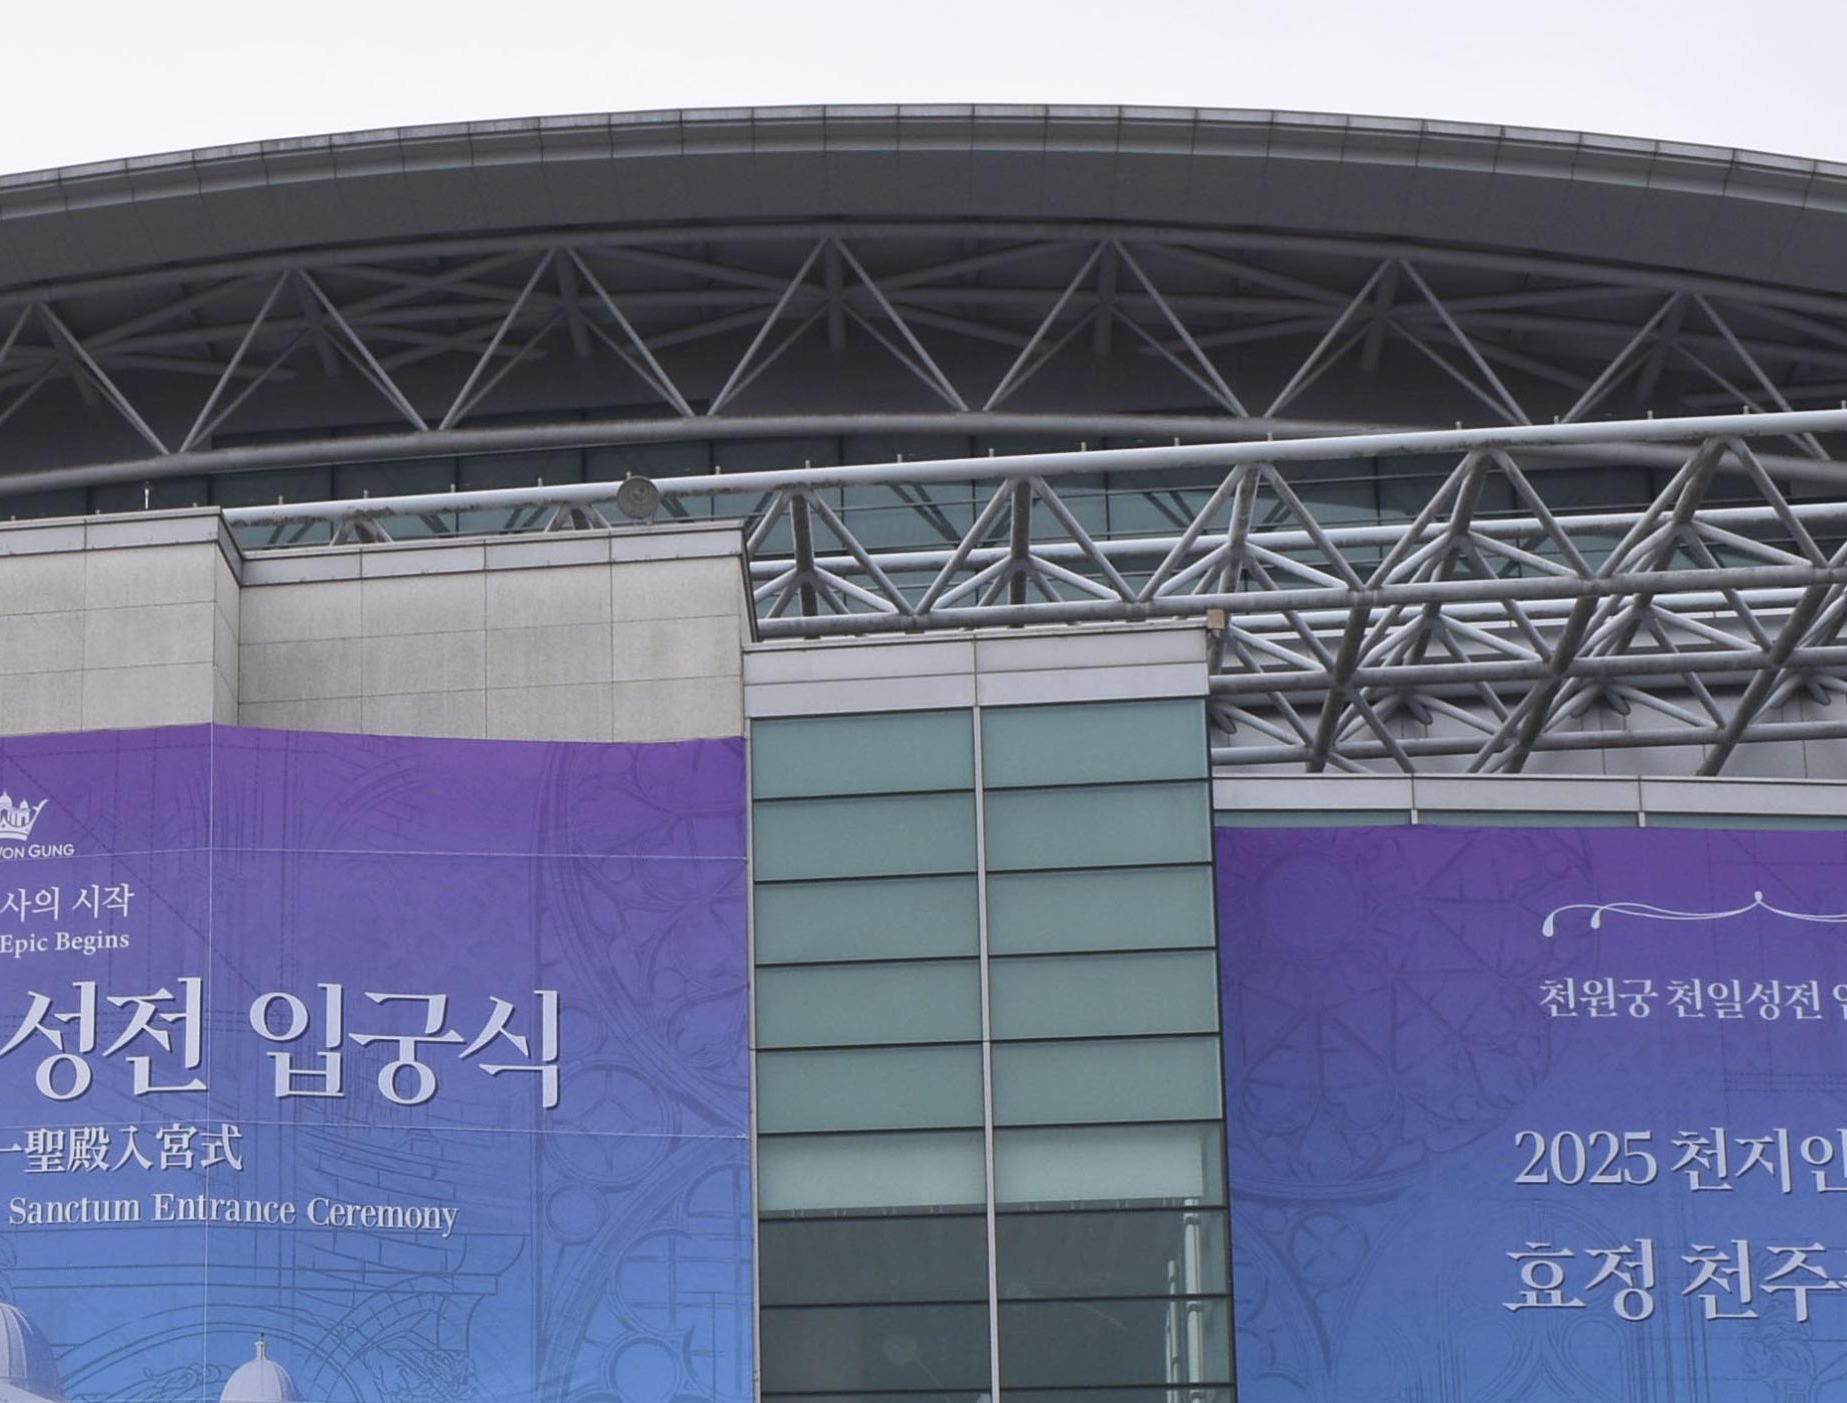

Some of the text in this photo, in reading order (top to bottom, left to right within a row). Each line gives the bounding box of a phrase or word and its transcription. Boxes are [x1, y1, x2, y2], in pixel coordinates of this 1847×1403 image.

[27, 843, 75, 858] GUNG
[72, 882, 135, 919] 시작
[0, 933, 48, 959] Epic
[55, 930, 130, 956] Begins
[1540, 977, 1659, 1018] 천원궁
[1666, 978, 1823, 1021] 천일성전
[249, 982, 558, 1108] 입궁식
[1514, 1130, 1657, 1184] 2025
[9, 1196, 140, 1225] Sanctum
[152, 1193, 295, 1224] Entrance
[307, 1197, 458, 1238] Ceremony
[1502, 1238, 1847, 1322] 효정 천주
